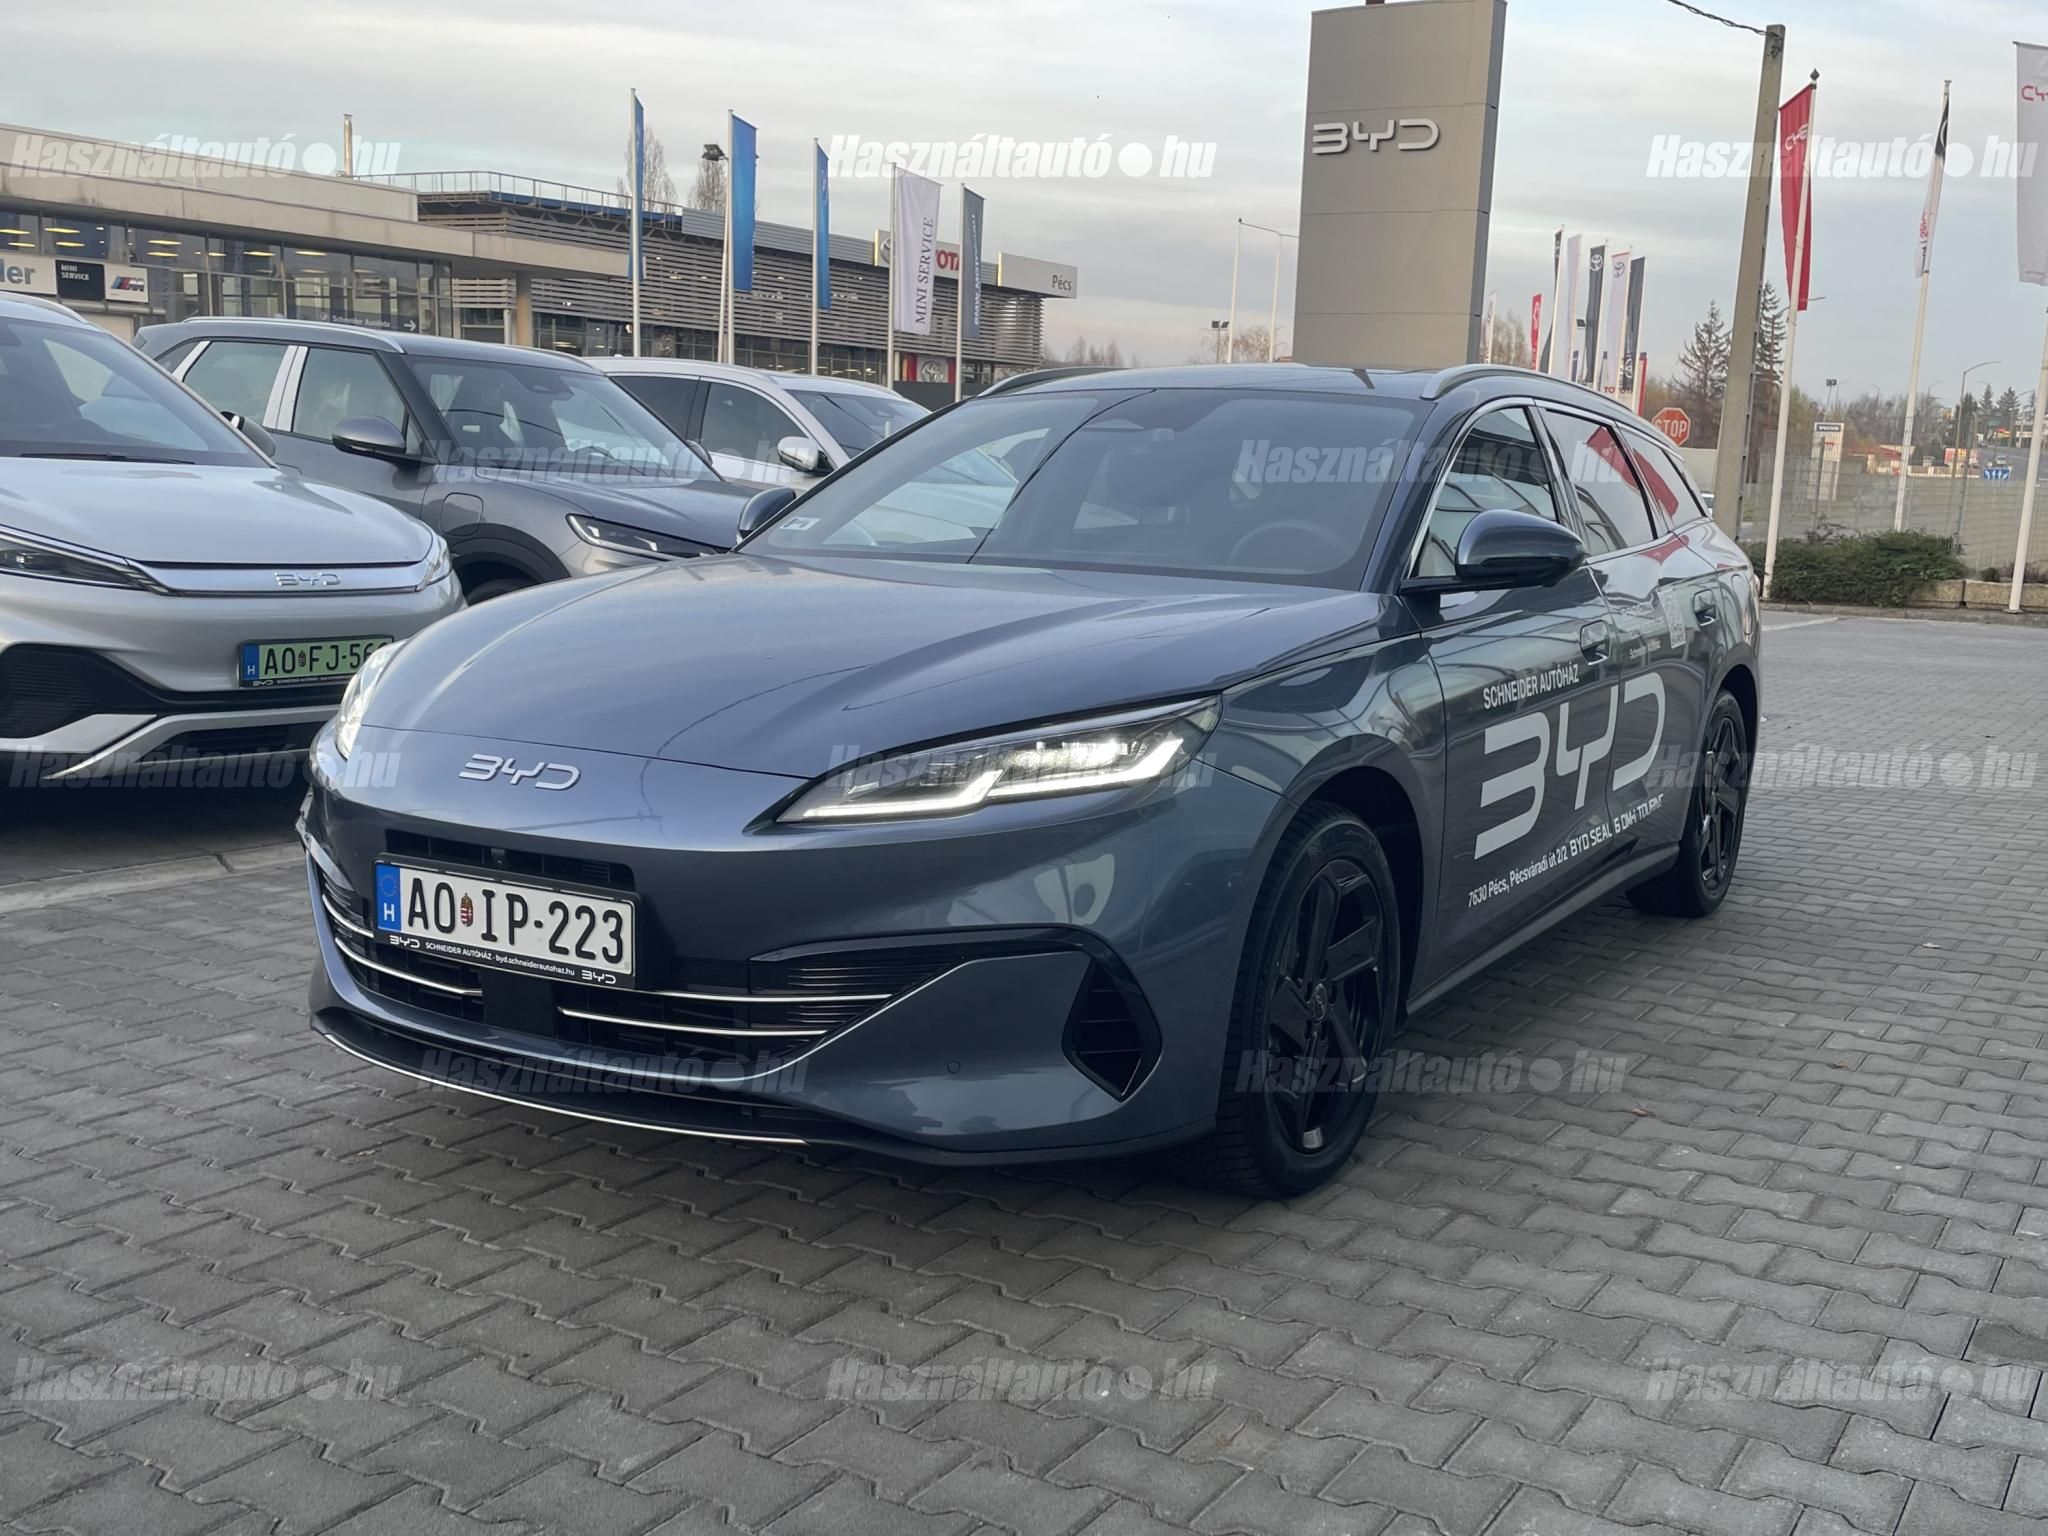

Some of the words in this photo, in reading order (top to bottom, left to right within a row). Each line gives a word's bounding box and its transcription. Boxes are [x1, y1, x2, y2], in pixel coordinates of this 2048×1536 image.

[1312, 118, 1440, 154] BYD
[917, 217, 934, 284] SERVICE
[61, 272, 90, 281] SERVICE
[1051, 274, 1073, 291] Pécs
[914, 288, 930, 325] MINI
[273, 573, 342, 586] BYD
[247, 664, 256, 675] H
[309, 641, 389, 673] FJ-56
[1483, 674, 1538, 709] SCHNEIDER
[1540, 664, 1580, 693] AUTÓHÁZ
[459, 753, 580, 790] BYD
[1474, 671, 1666, 860] BYD
[1468, 884, 1488, 908] 7630
[1569, 833, 1590, 857] BYD
[1589, 822, 1613, 847] SEAL
[384, 902, 396, 922] H
[389, 934, 421, 949] BYD
[425, 941, 462, 955] SCHNEIDER
[462, 947, 493, 960] AUTÓHÁZ
[581, 969, 617, 985] BYD
